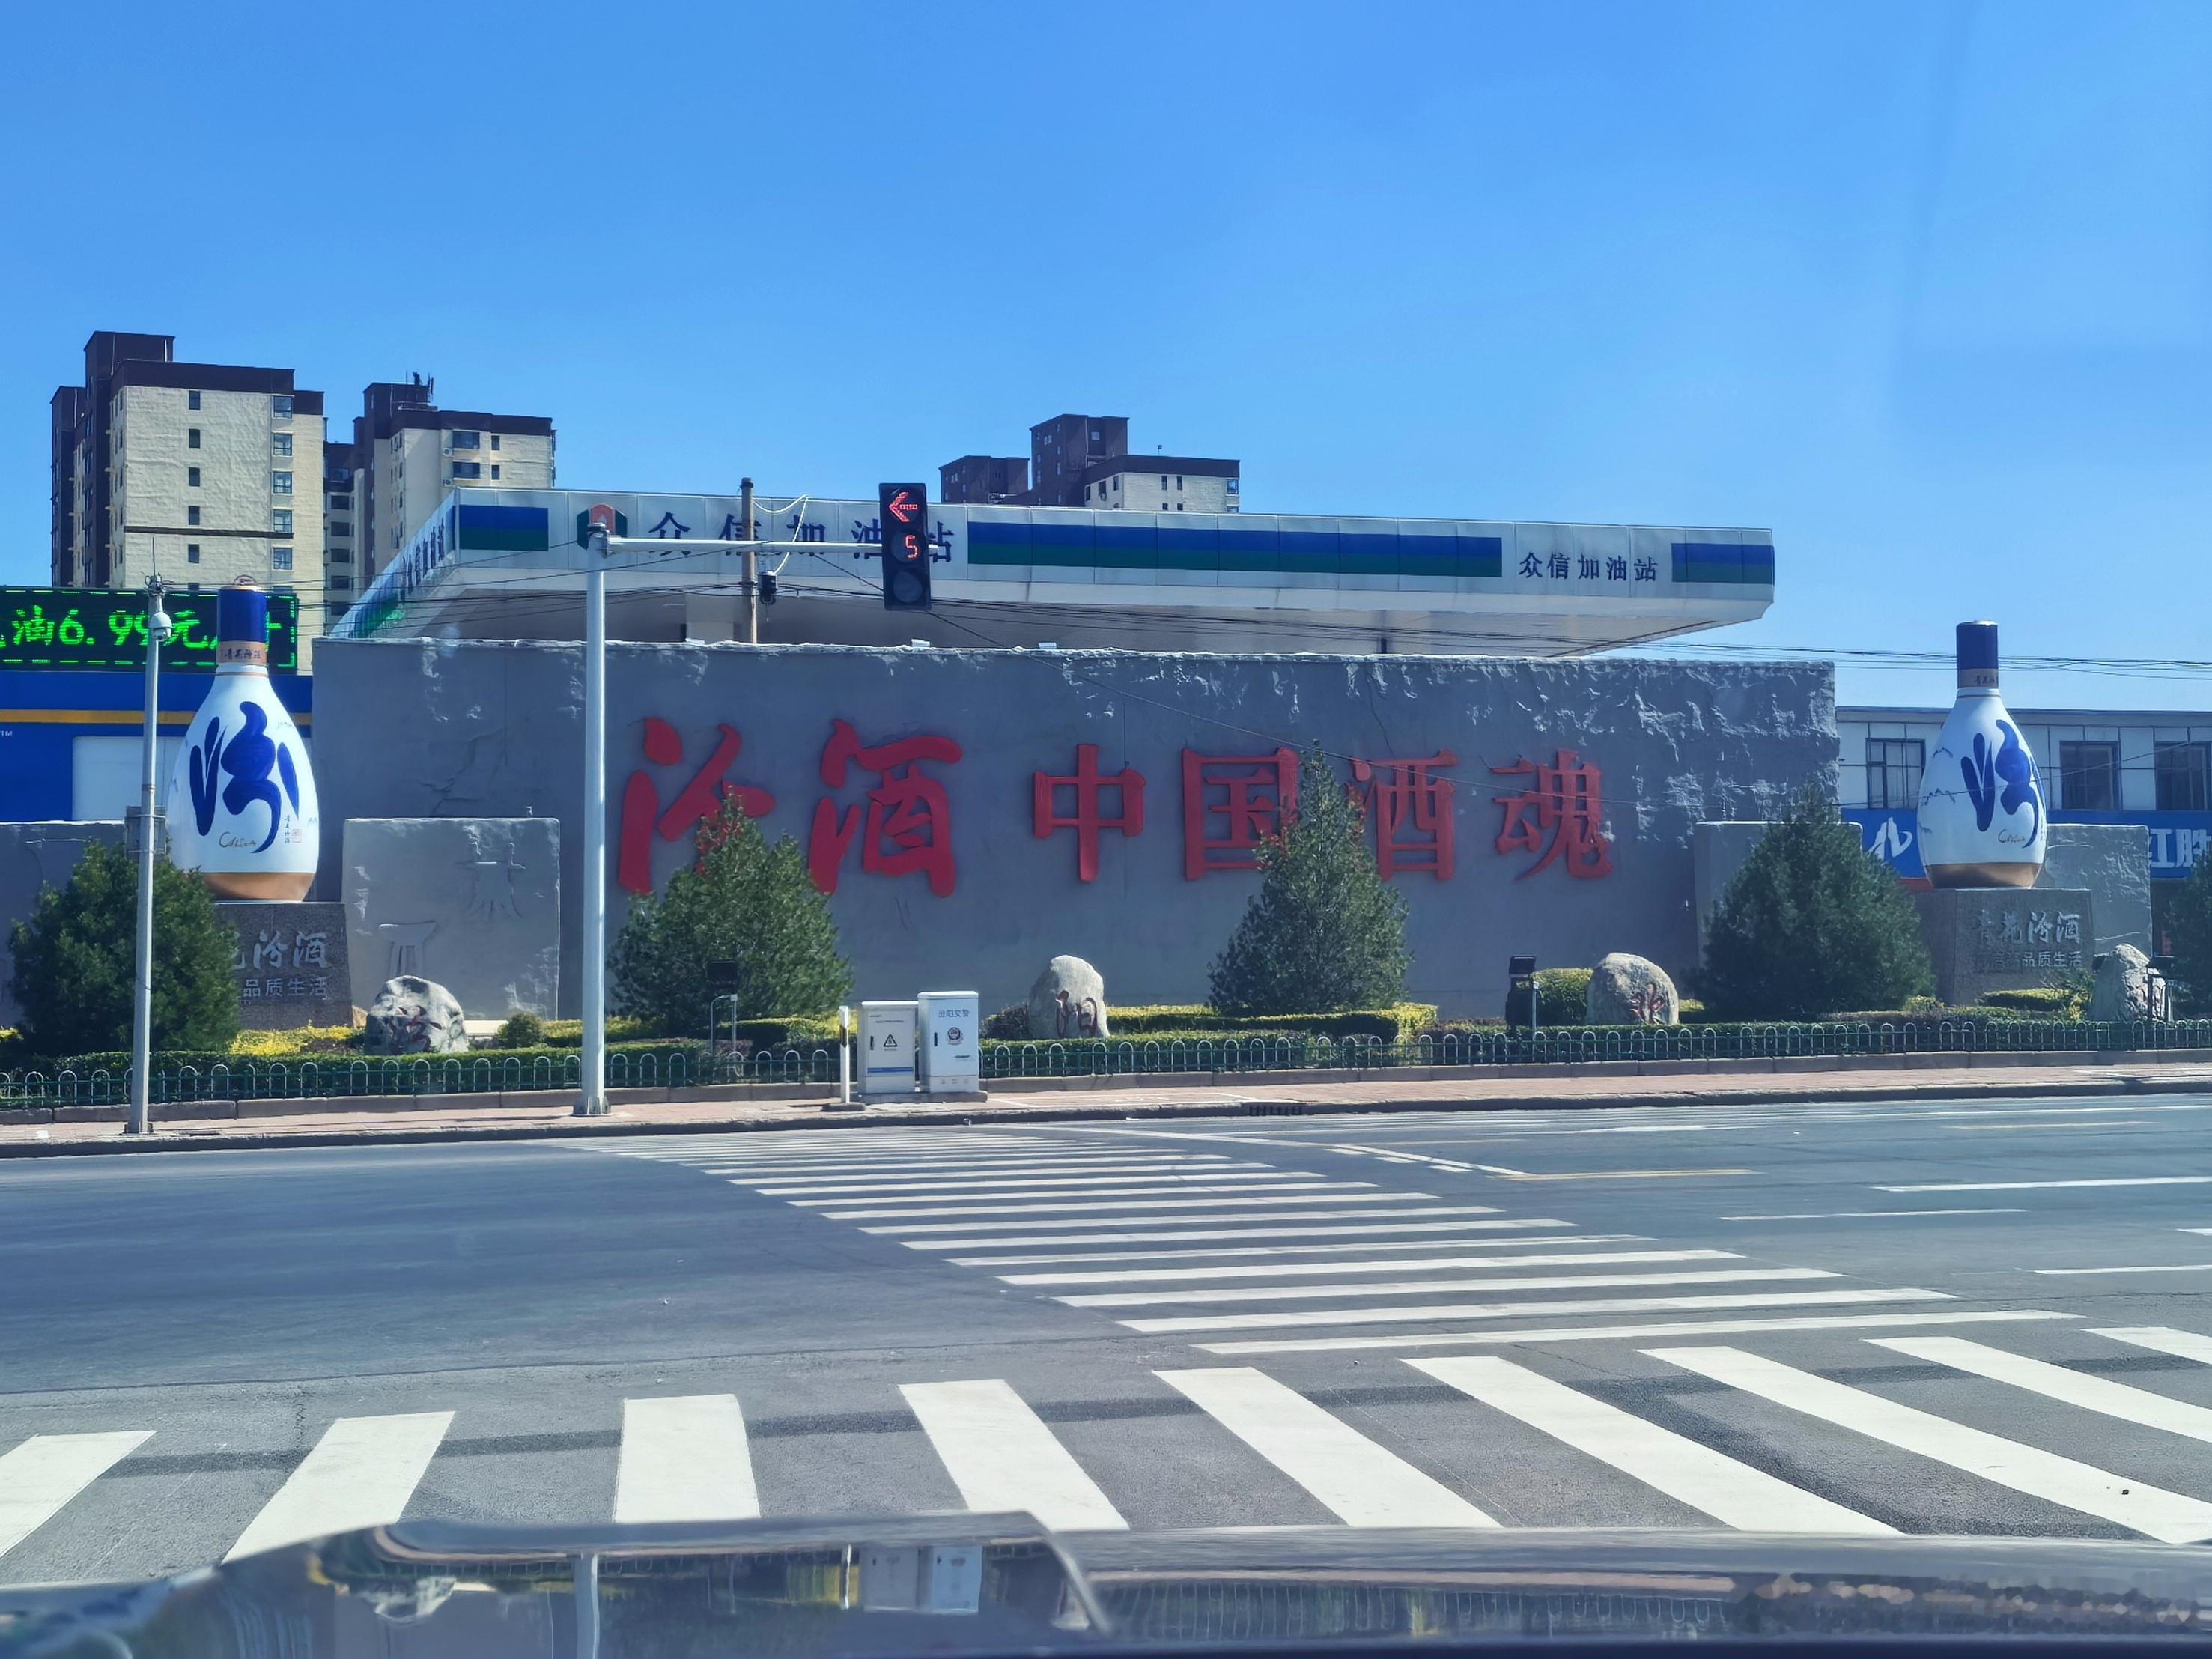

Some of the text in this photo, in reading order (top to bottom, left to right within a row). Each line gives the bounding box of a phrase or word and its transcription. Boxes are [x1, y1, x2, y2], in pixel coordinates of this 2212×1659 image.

[905, 534, 919, 558] 5
[1519, 552, 1658, 582] 众信加油站
[1033, 743, 1614, 885] 中国酒魂
